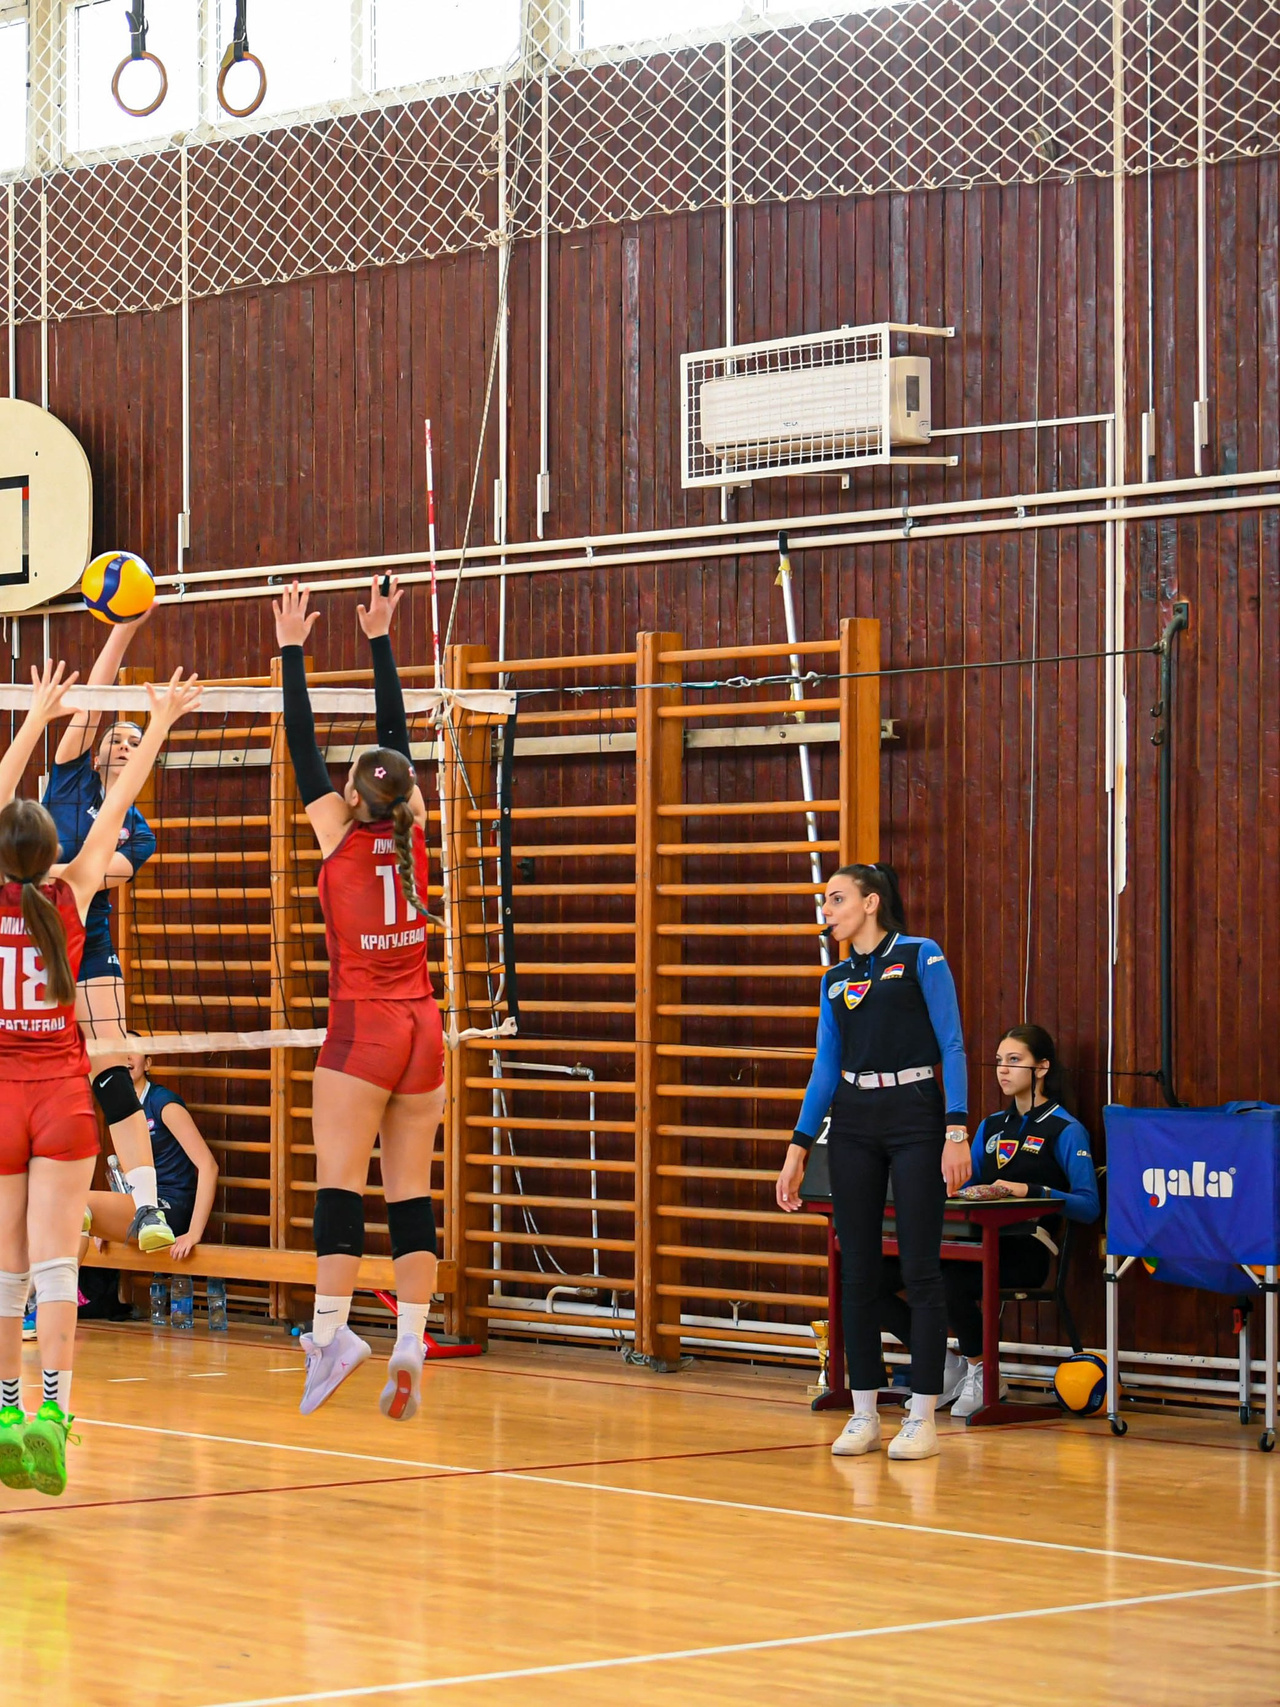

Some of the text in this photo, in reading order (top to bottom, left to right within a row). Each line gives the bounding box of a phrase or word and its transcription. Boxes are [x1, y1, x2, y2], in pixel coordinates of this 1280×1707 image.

[361, 927, 425, 950] КРАГУЈЕВАЦ
[816, 1116, 832, 1145] 2
[1142, 1161, 1233, 1208] gala
